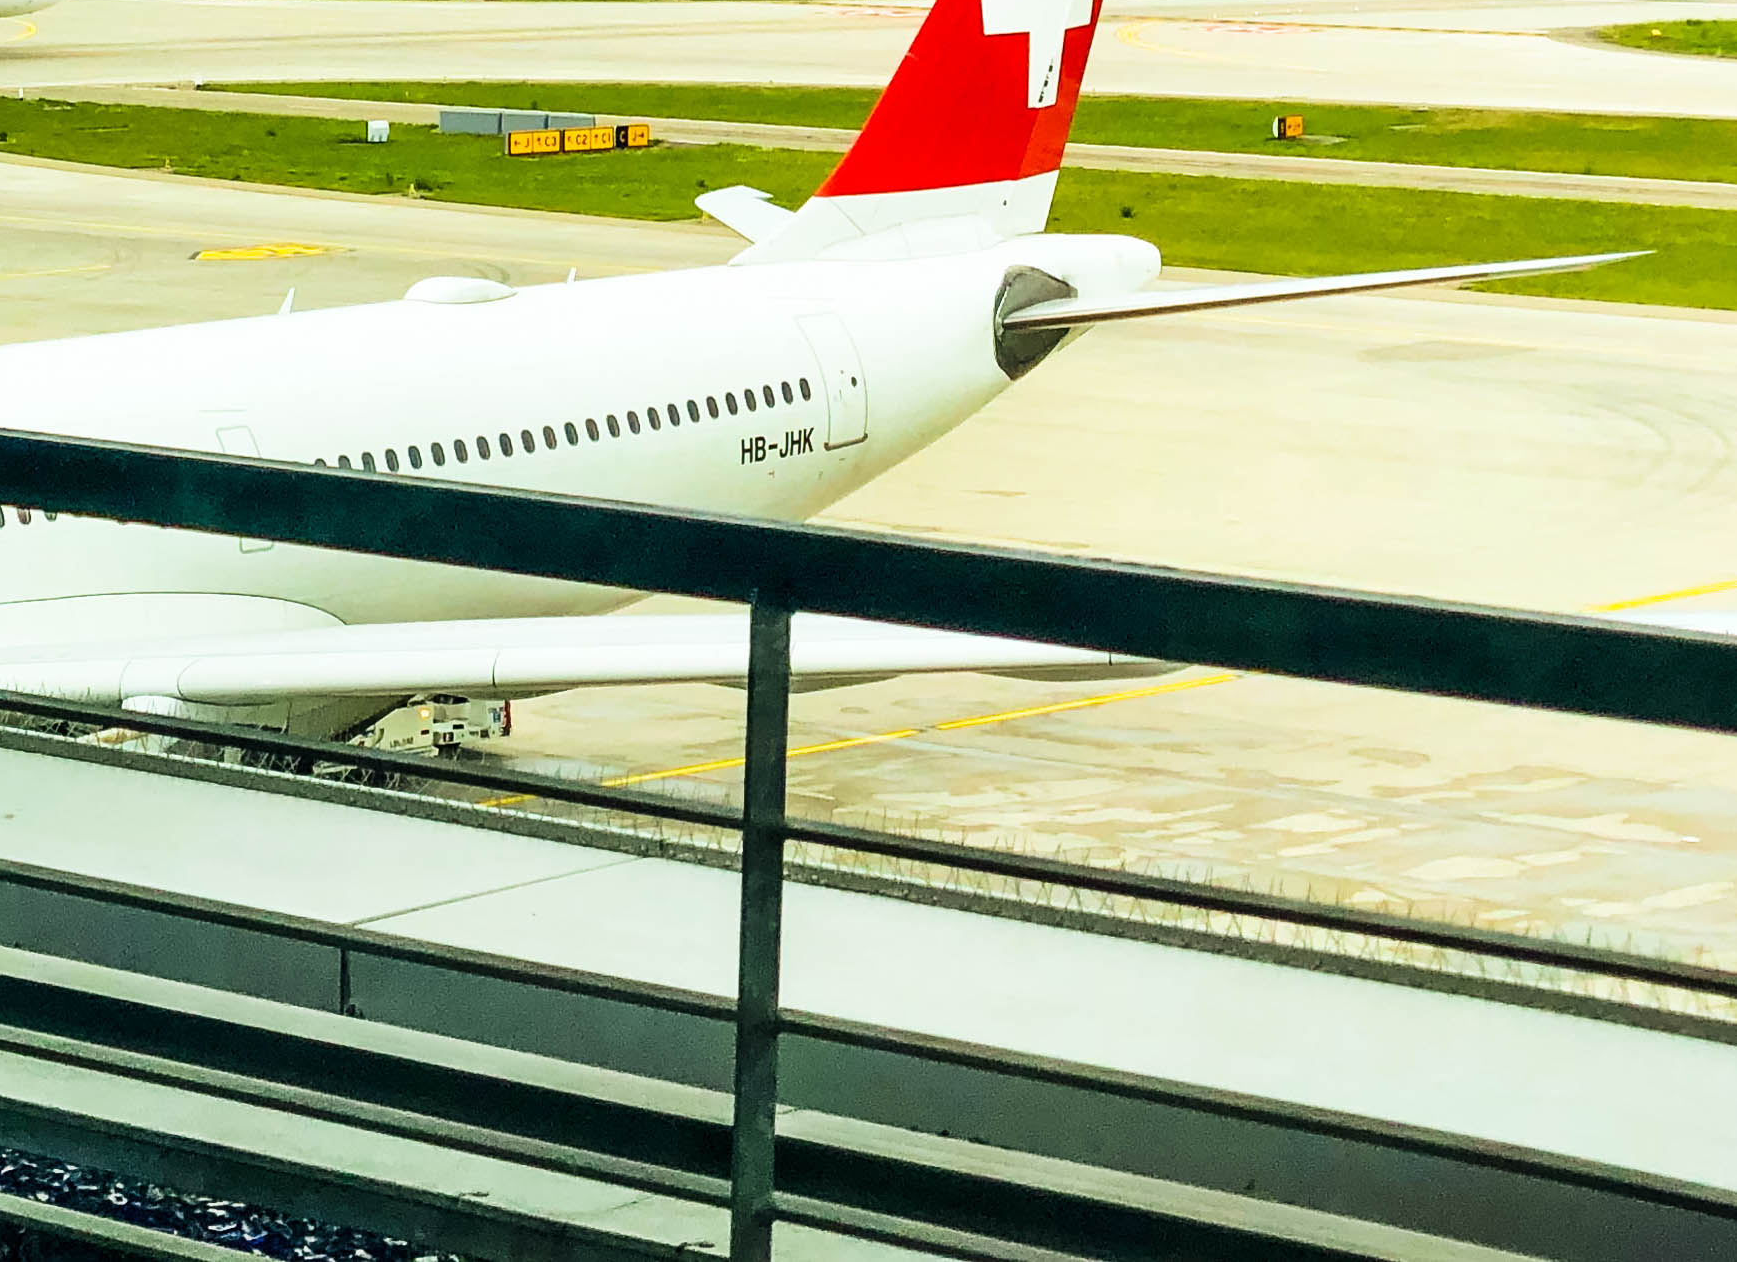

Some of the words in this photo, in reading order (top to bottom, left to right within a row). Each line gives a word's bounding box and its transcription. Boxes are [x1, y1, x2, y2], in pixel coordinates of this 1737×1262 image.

[575, 134, 588, 145] C2
[619, 130, 626, 142] C
[741, 427, 814, 465] HB-JHK
